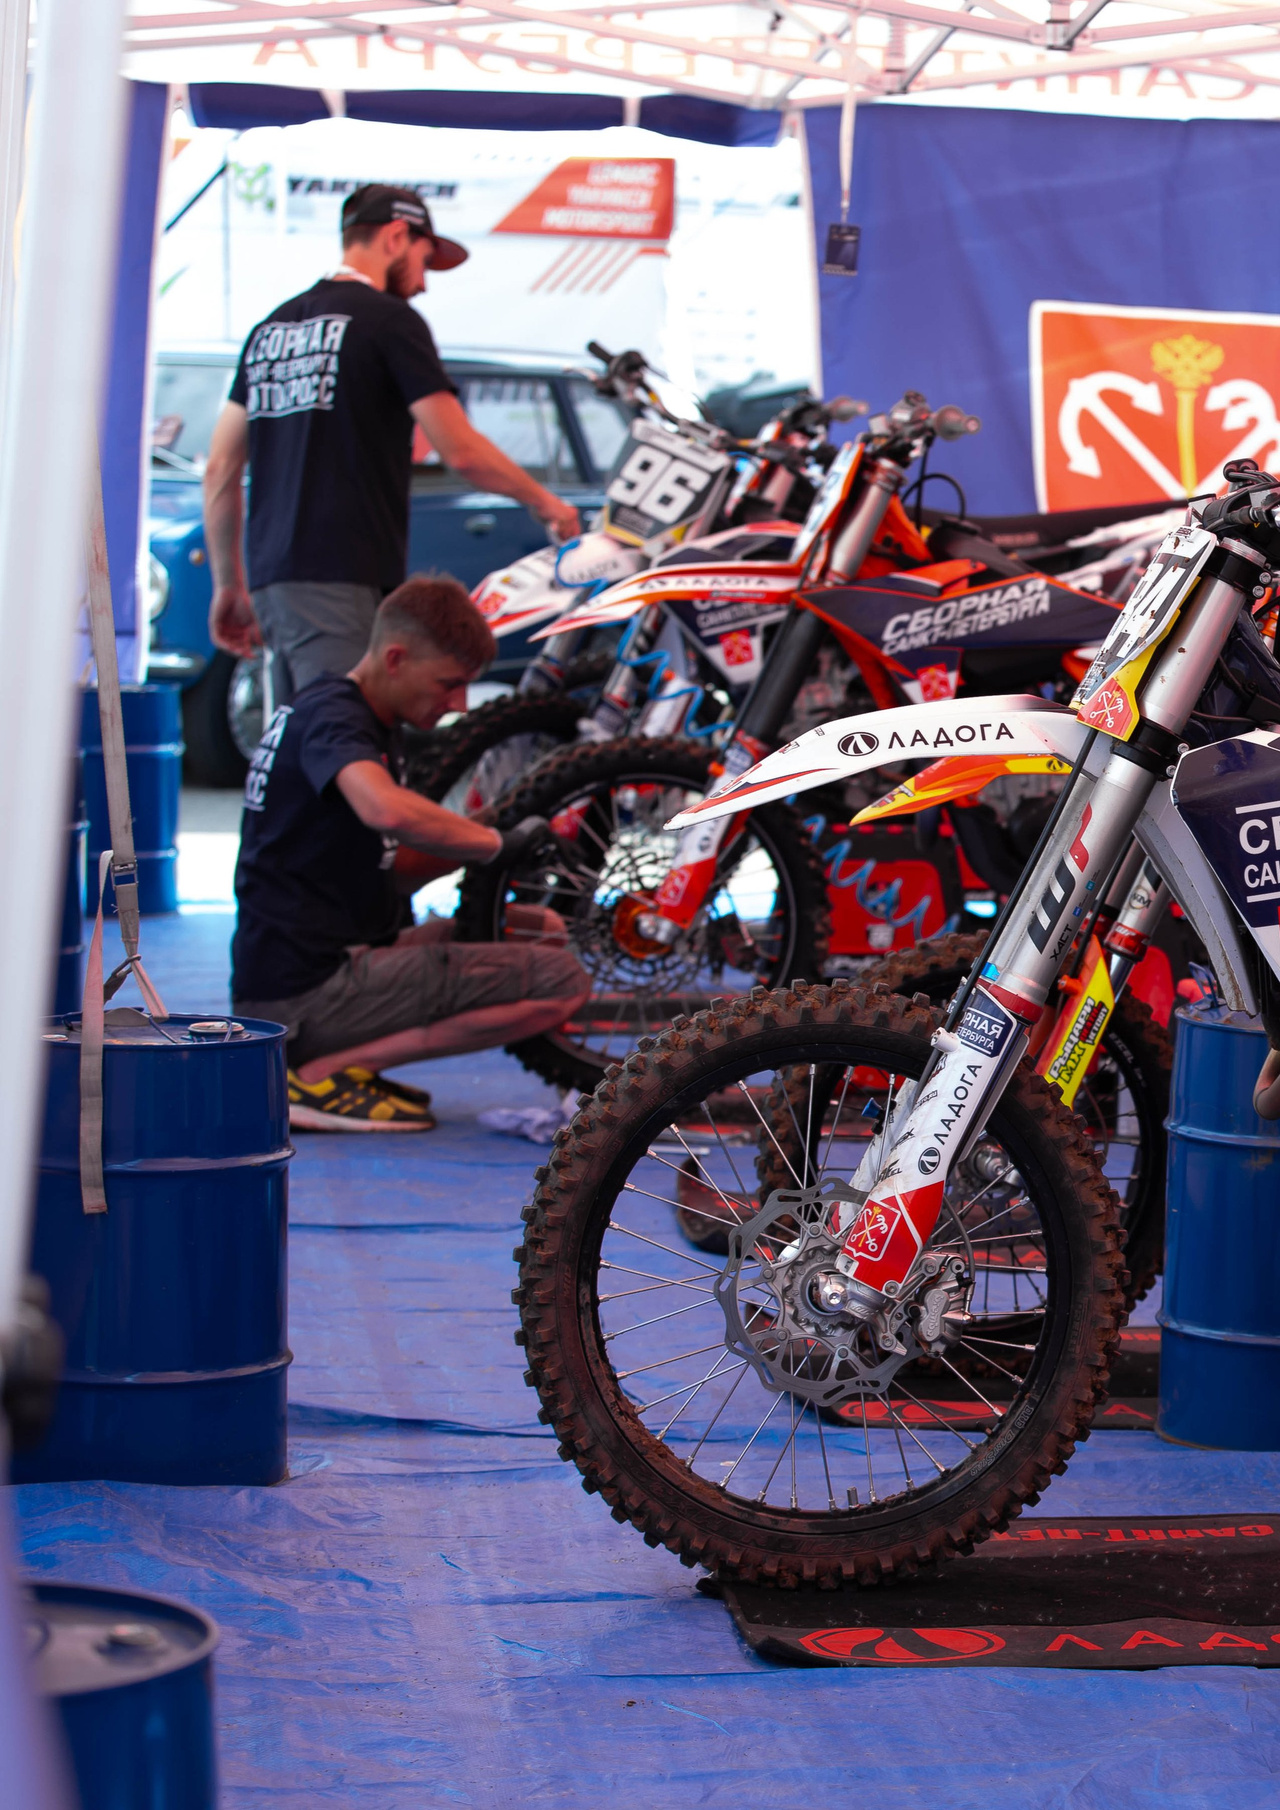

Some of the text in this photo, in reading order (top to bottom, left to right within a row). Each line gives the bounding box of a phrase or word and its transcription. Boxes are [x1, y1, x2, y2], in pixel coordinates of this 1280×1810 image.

[606, 443, 713, 525] 96
[881, 577, 1048, 642] СБОРНАЯ
[888, 721, 1015, 750] ЛАДОГА
[1050, 923, 1073, 962] XACT
[956, 1024, 995, 1050] ЕТЕРБУРГА
[959, 1011, 1004, 1040] РНАЯ
[934, 1063, 982, 1146] ЛАДОГА
[989, 1524, 1275, 1542] САНКТ-ПЕТ
